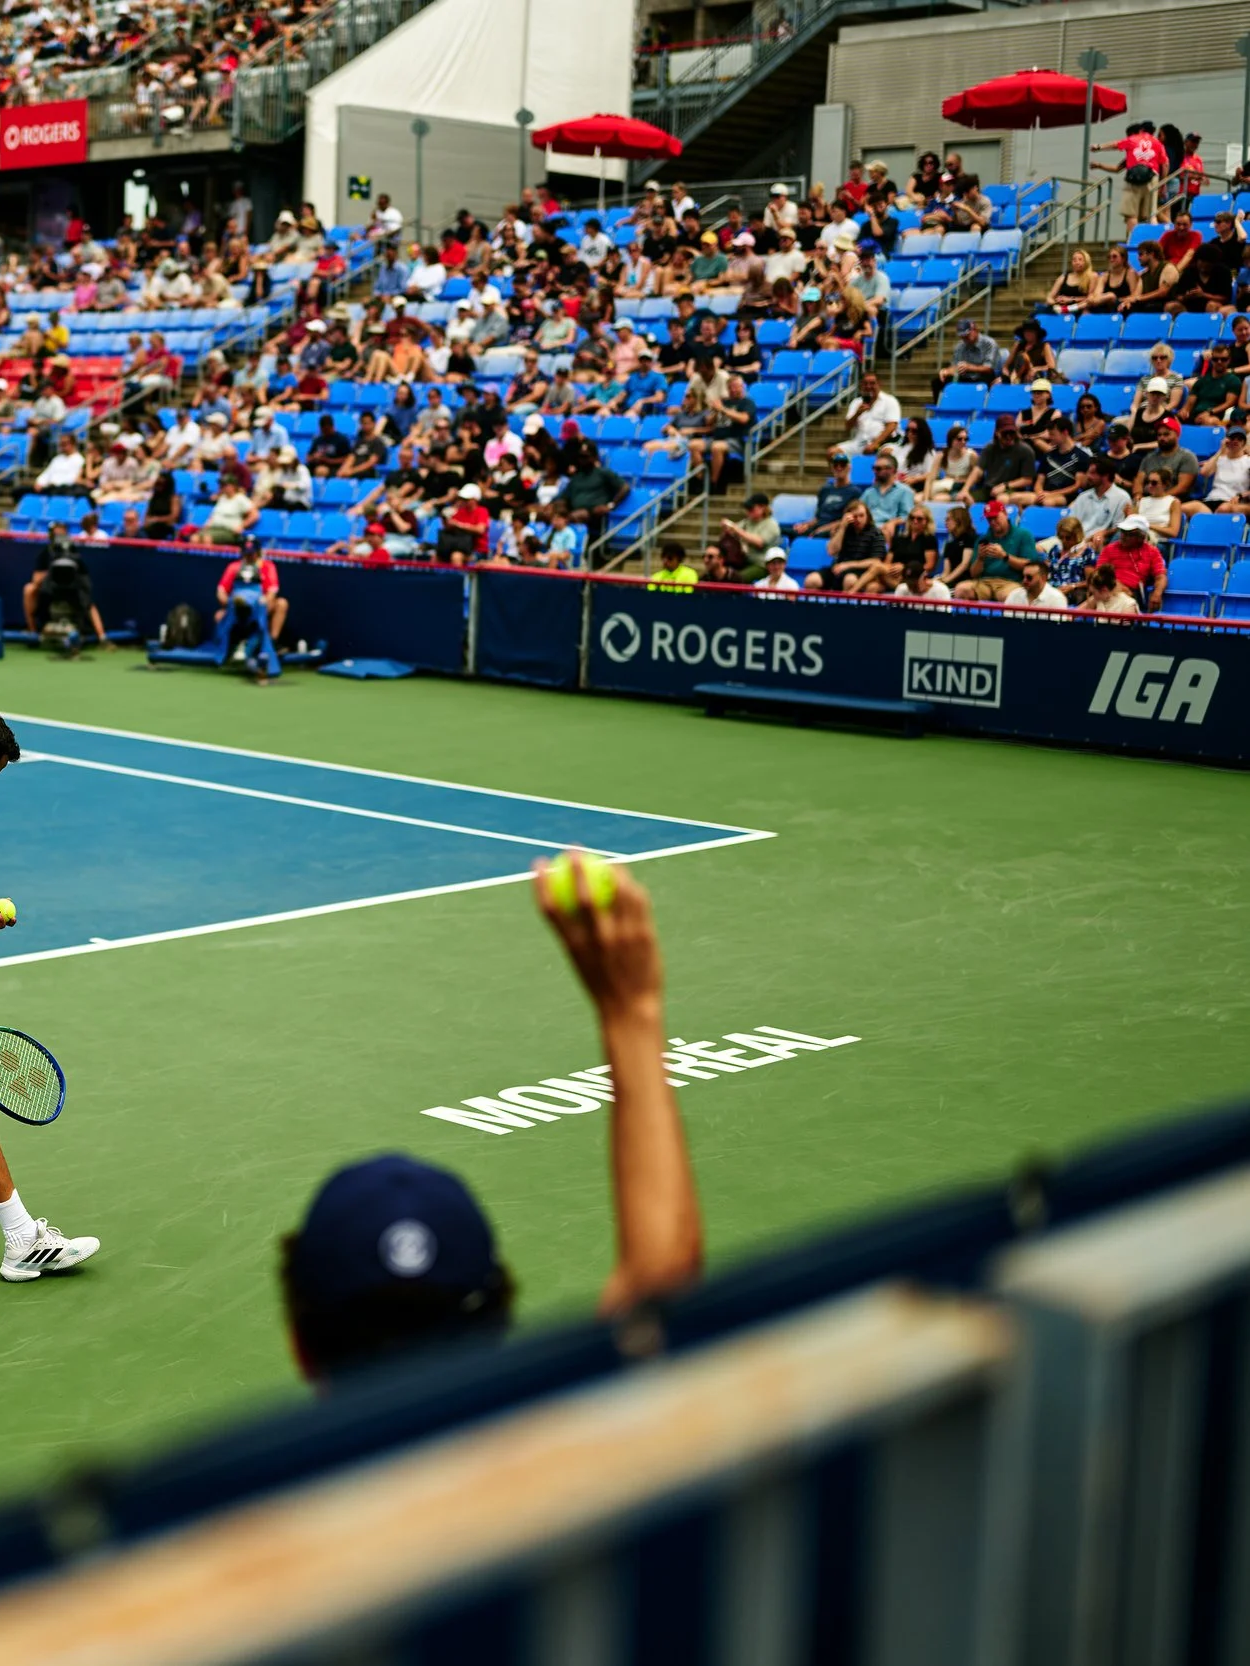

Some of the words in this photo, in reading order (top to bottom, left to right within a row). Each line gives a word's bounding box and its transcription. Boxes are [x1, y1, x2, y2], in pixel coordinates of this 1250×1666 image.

[20, 120, 81, 146] ROGERS
[651, 621, 823, 676] ROGERS
[911, 661, 993, 697] KIND
[1087, 650, 1220, 725] IGA
